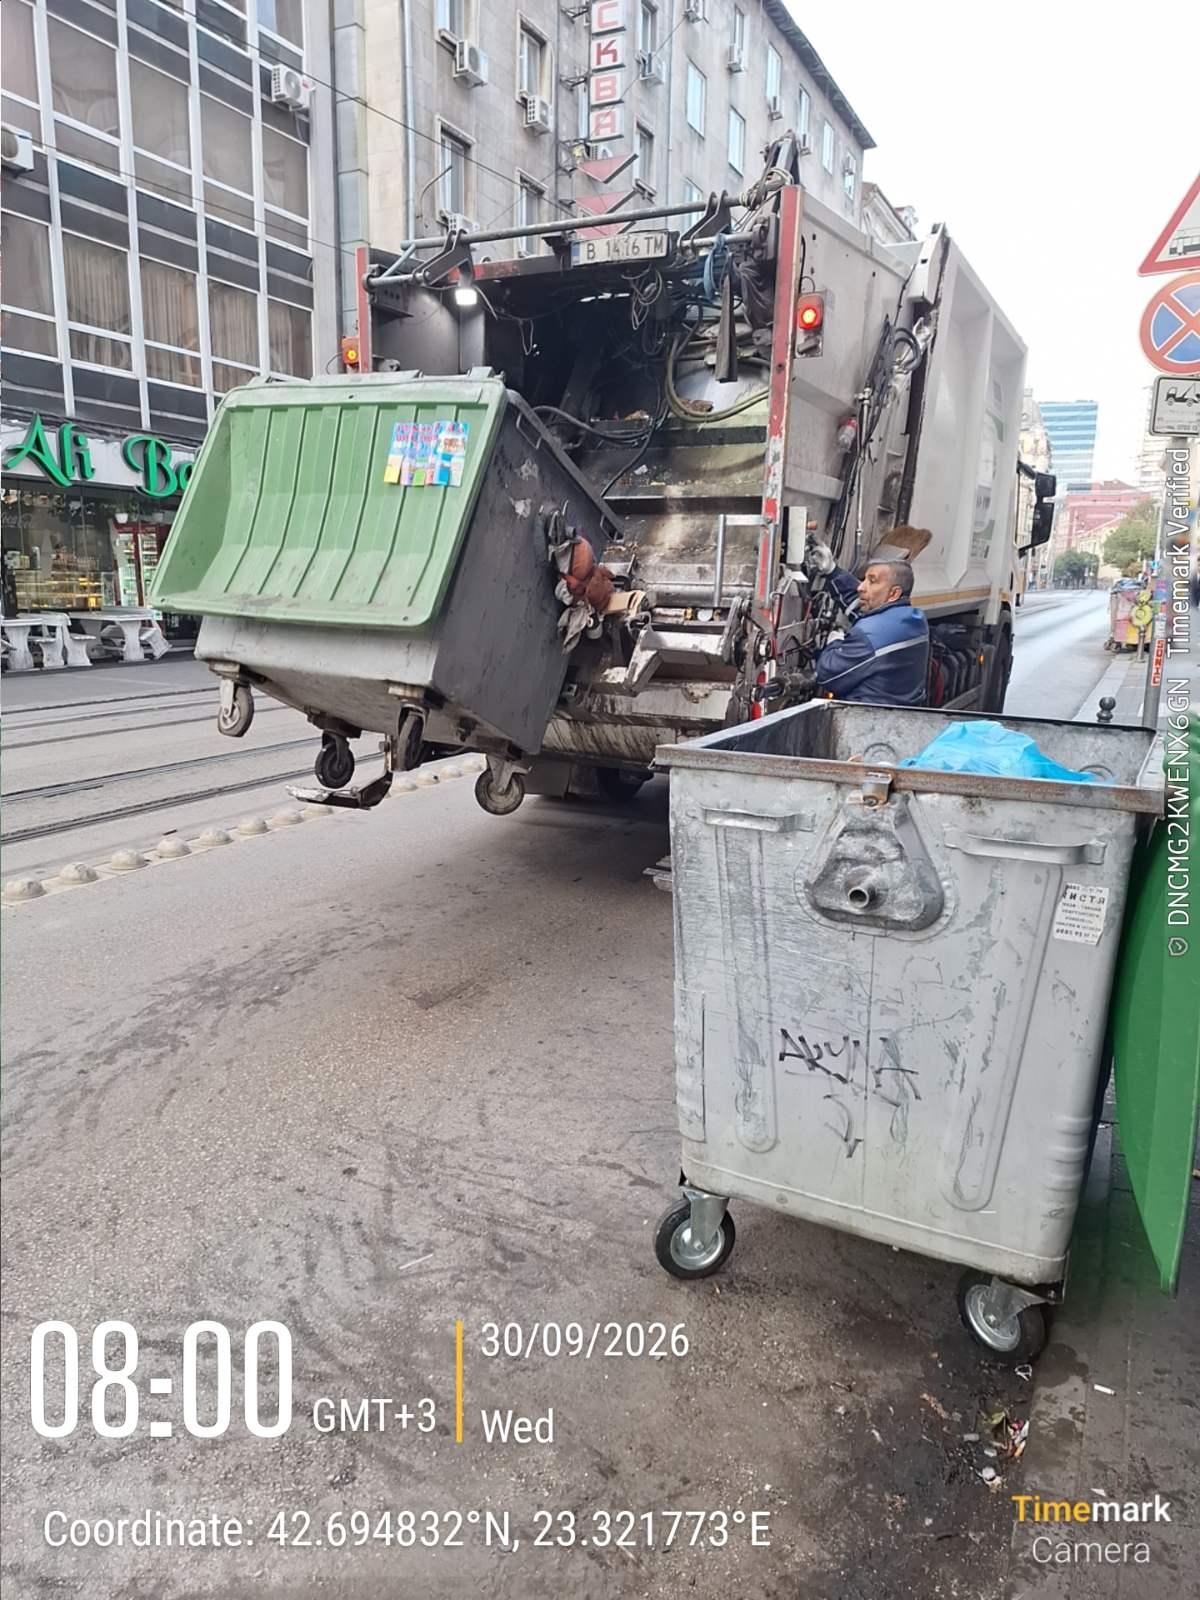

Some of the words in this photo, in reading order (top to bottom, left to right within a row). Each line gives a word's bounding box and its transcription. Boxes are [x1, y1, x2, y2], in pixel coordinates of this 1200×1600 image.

[587, 242, 596, 260] B
[644, 235, 664, 255] TM
[2, 410, 96, 488] Ali
